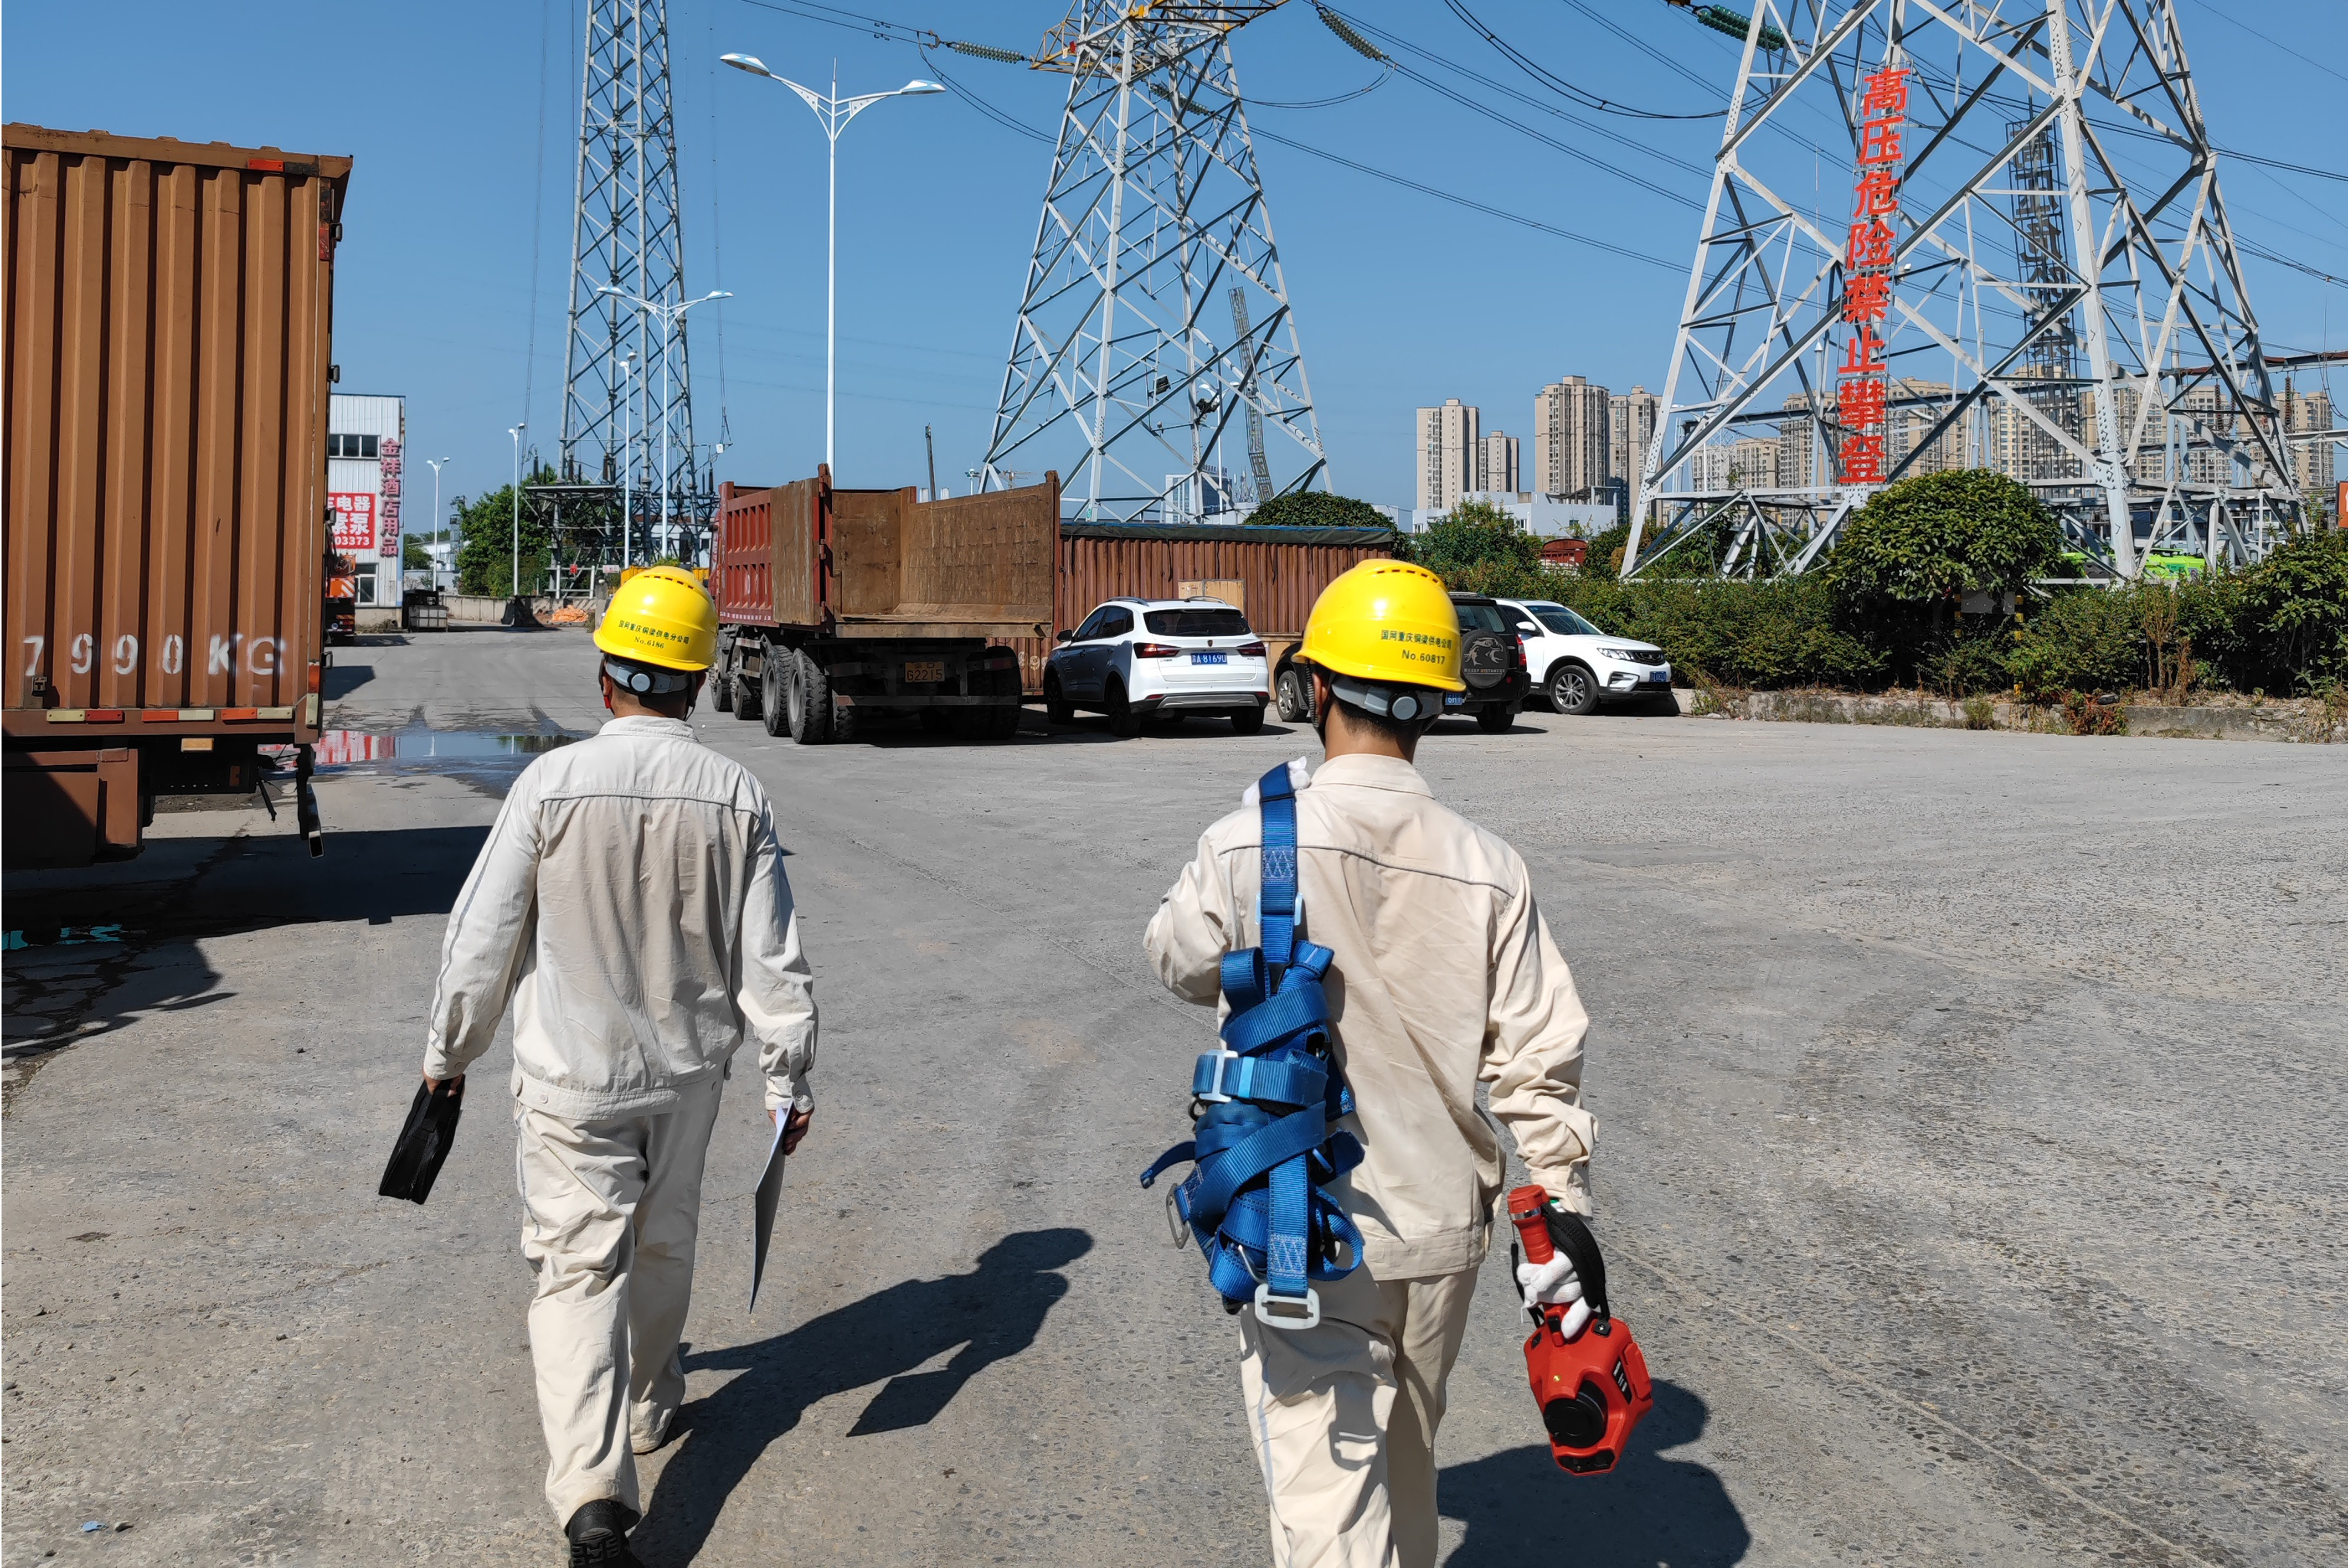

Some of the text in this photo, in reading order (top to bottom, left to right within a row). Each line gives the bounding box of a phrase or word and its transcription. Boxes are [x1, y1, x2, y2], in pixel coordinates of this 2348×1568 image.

[1838, 67, 1910, 483] 高压危险禁止攀登
[380, 439, 400, 555] 金祥酒店用品
[907, 669, 943, 680] G2215
